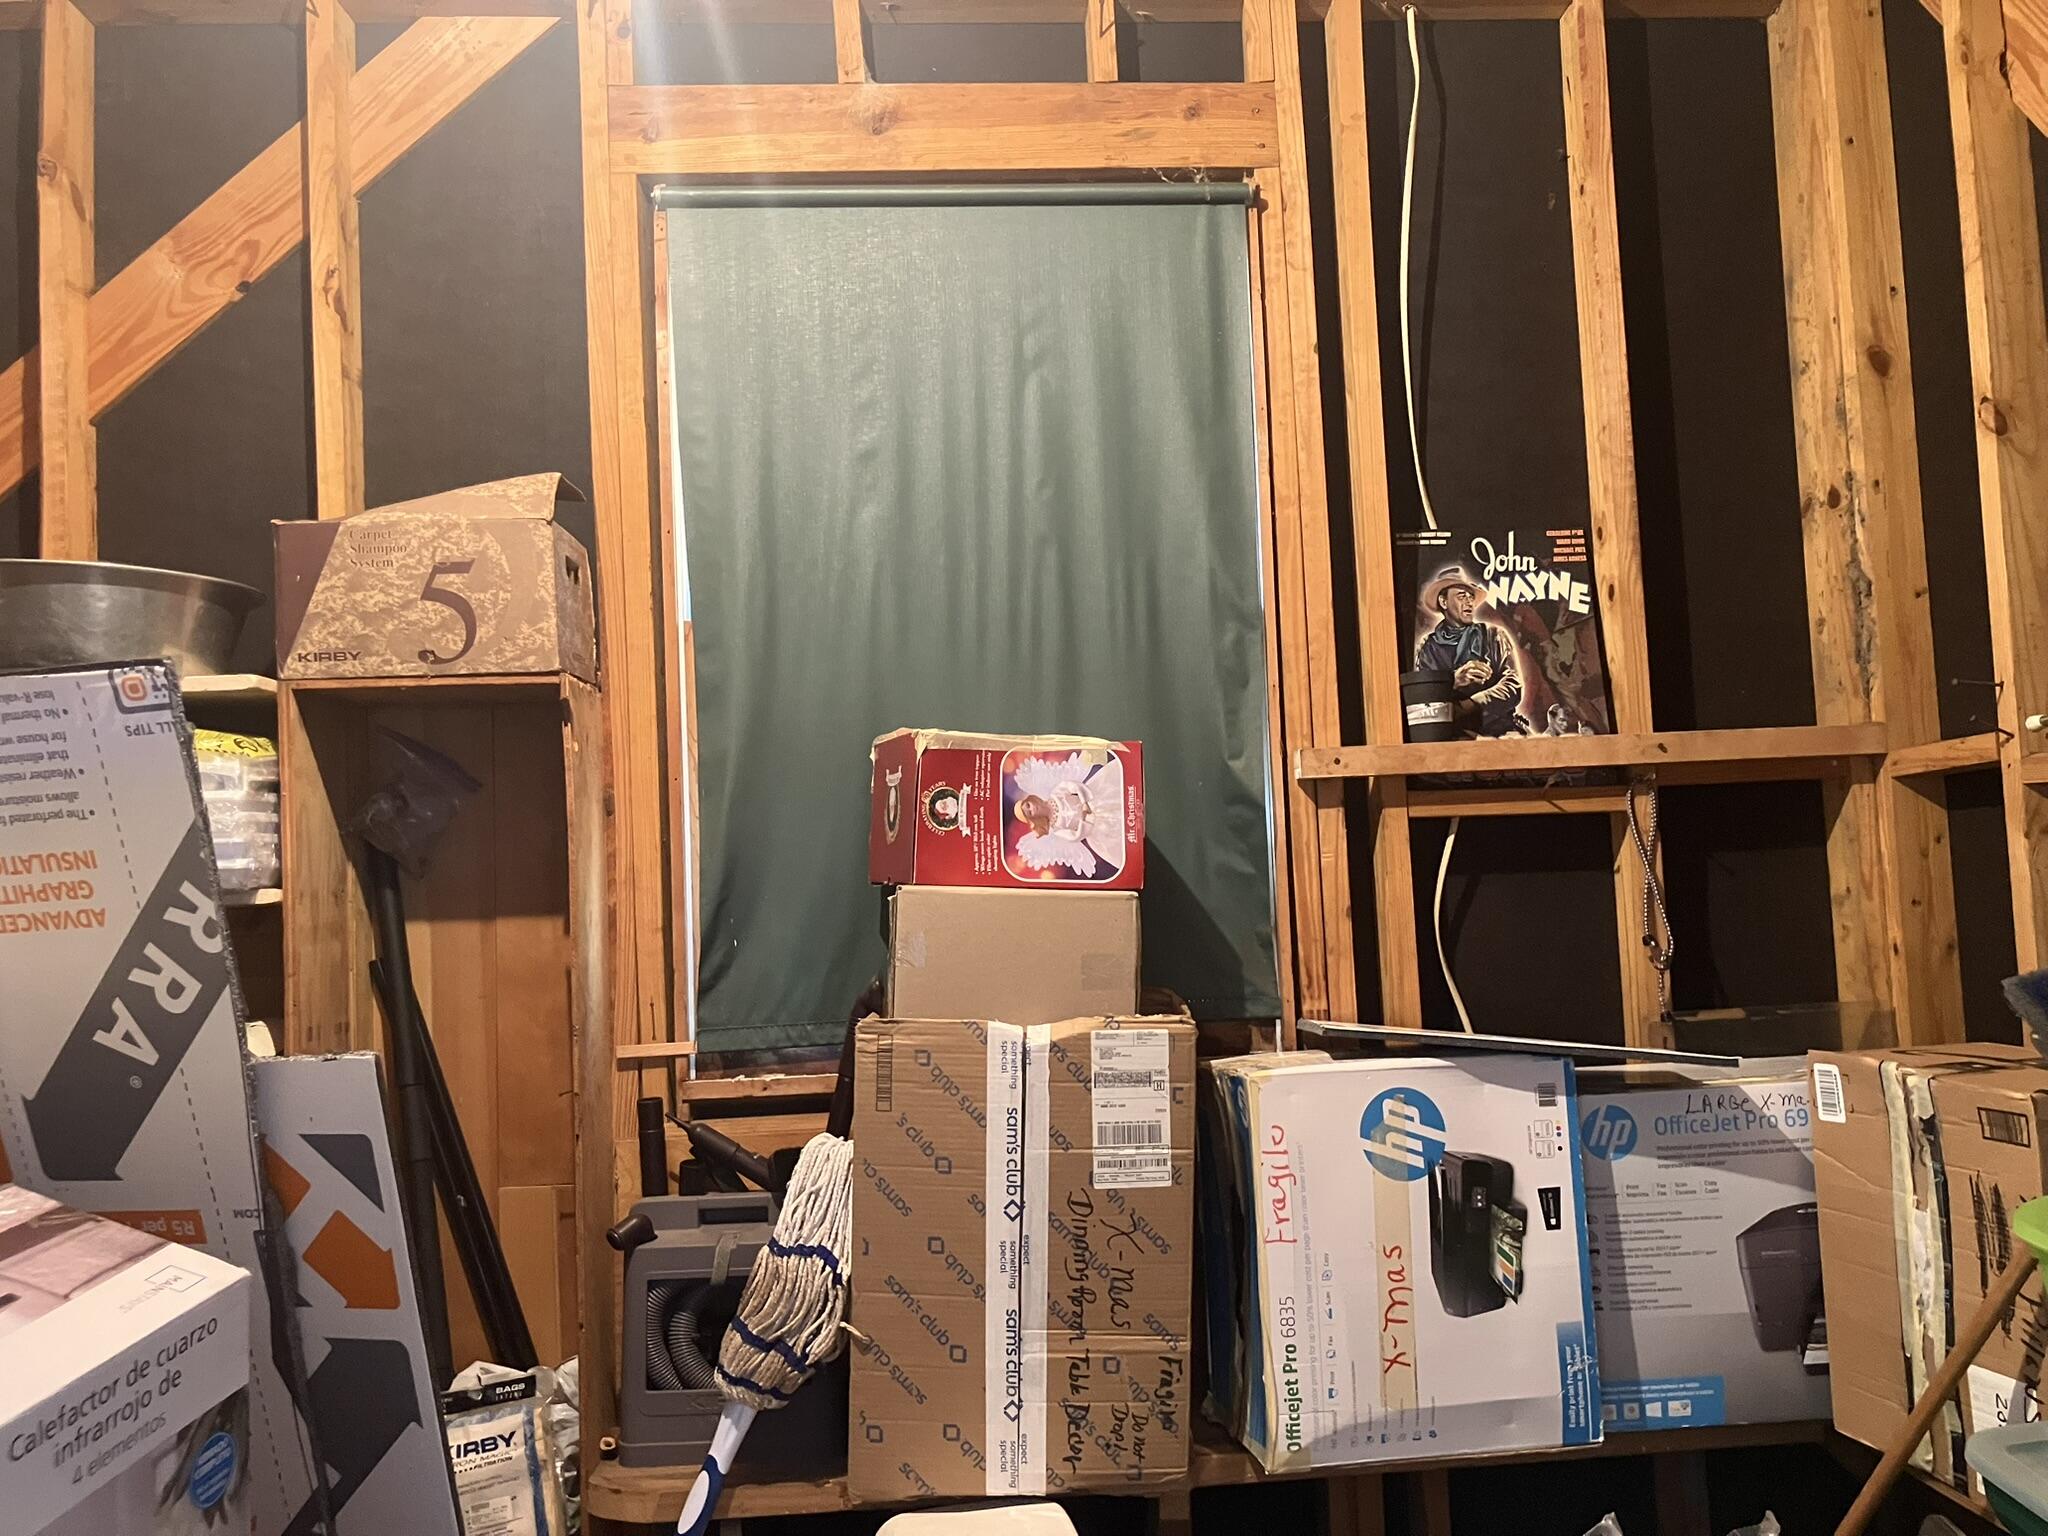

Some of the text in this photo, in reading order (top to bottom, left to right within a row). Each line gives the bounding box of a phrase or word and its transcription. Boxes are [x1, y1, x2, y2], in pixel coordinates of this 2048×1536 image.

[349, 543, 408, 555] Shampoo
[350, 529, 392, 541] Carpet
[349, 557, 394, 568] System
[1470, 531, 1538, 580] John
[1478, 571, 1591, 615] WAYNE
[417, 557, 477, 665] 5
[297, 651, 362, 663] KIRBY
[1, 709, 61, 724] No thermal
[124, 721, 174, 737] LL TIPS
[16, 731, 67, 745] for house
[47, 750, 69, 762] that
[30, 768, 77, 782] Weather
[45, 791, 79, 803] allows
[1126, 785, 1136, 827] Christmas
[9, 808, 89, 827] The perforated
[0, 850, 97, 876] INSULATI
[1000, 1040, 1008, 1074] special
[1008, 1040, 1018, 1090] something
[930, 1063, 960, 1097] club
[1360, 1090, 1447, 1176] hp
[1589, 1105, 1634, 1160] hp
[1654, 1108, 1809, 1137] OfficeJet Pro 69
[906, 1126, 935, 1157] club
[1006, 1107, 1021, 1196] sam's club
[140, 1217, 195, 1236] R5 per
[998, 1240, 1008, 1274] special
[1007, 1240, 1018, 1289] something
[1022, 1234, 1030, 1265] expect
[945, 1252, 975, 1286] club
[919, 1314, 950, 1346] club
[1308, 1333, 1317, 1343] up
[1005, 1308, 1020, 1397] sam's club
[1308, 1345, 1316, 1356] for
[9, 1317, 218, 1461] Calefactor de cuarzo
[495, 1382, 526, 1394] BAGS
[1279, 1296, 1303, 1452] Officejet Pro 6835
[54, 1369, 182, 1468] infrarrojo de
[1995, 1392, 2009, 1428] 20
[72, 1464, 84, 1485] 4
[88, 1411, 167, 1477] elementos
[450, 1430, 517, 1460] IRBY
[1131, 1412, 1149, 1464] Do not
[999, 1439, 1007, 1473] special
[1008, 1440, 1018, 1489] something
